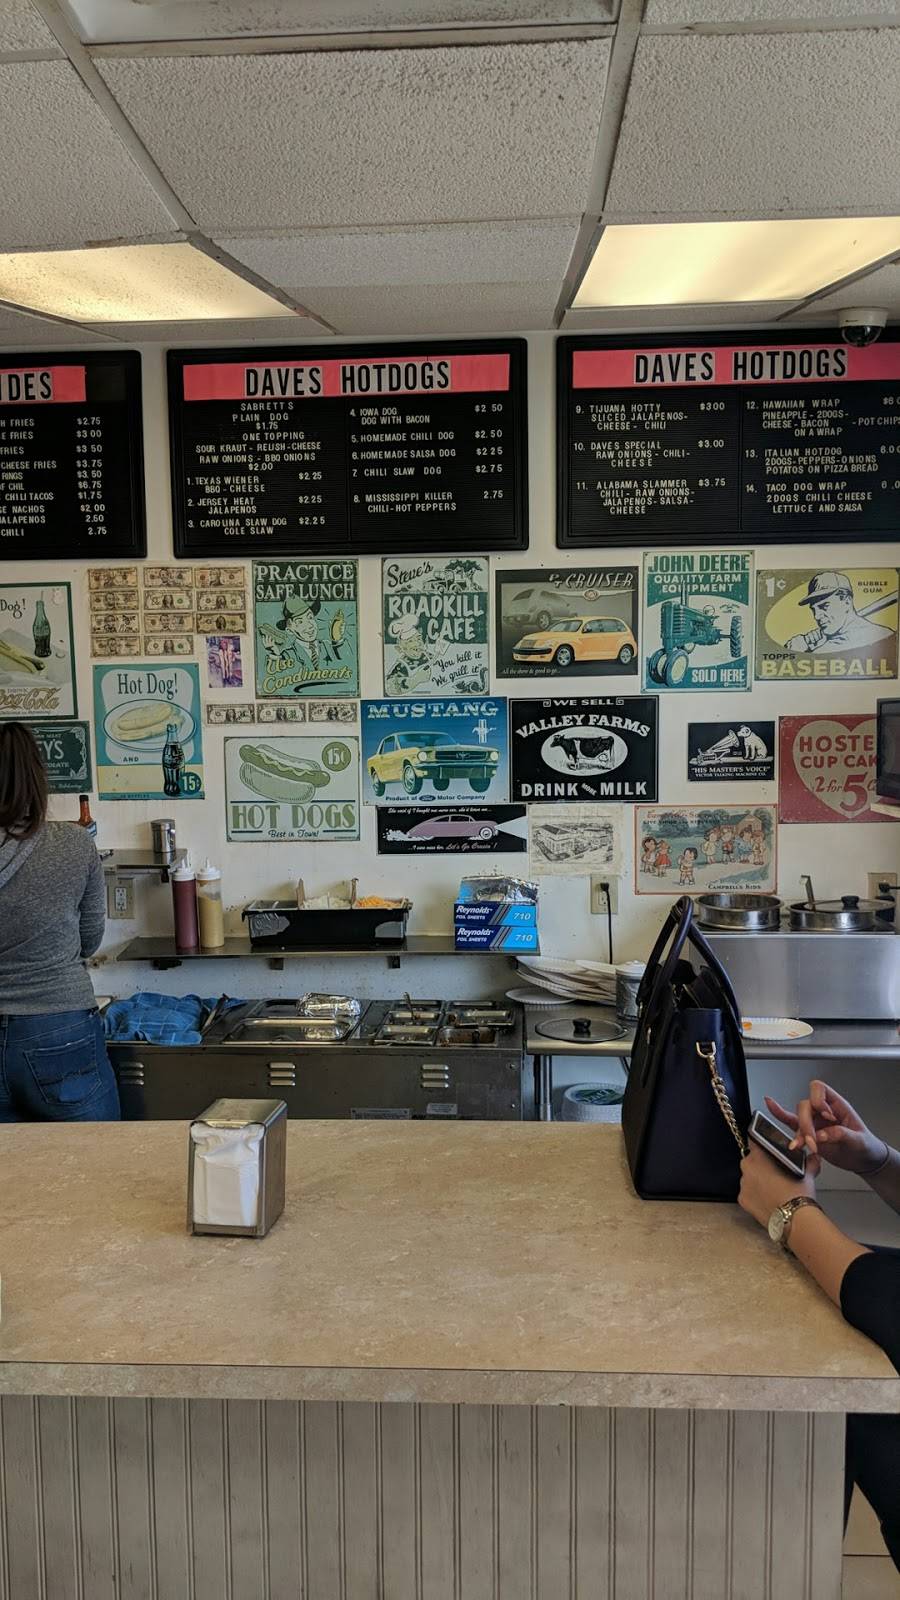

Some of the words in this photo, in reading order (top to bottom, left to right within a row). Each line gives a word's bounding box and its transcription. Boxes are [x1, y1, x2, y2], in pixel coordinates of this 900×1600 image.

[636, 352, 712, 382] DAVES
[734, 349, 846, 380] HOTDOGS
[246, 368, 321, 396] DAVES
[342, 361, 448, 393] HOTDOGS
[0, 372, 52, 401] DES
[763, 400, 804, 408] HAWAIIAN
[812, 400, 840, 408] WRAP
[590, 404, 626, 414] TIJUANA
[631, 404, 660, 412] HOTTY
[232, 414, 260, 422] PLAIN
[380, 416, 401, 424] WITH
[406, 415, 430, 423] BACON
[592, 413, 626, 422] SLICED
[763, 412, 806, 420] PINEAPPLE
[10, 418, 34, 427] FRIES
[256, 422, 278, 430] $1.75
[644, 422, 666, 430] CHILI
[10, 432, 34, 440] FRIES
[817, 428, 842, 436] WRAP
[243, 433, 260, 441] ONE
[361, 434, 406, 442] HOMEMADE
[196, 445, 216, 453] SOUR
[591, 442, 619, 450] DAVES
[625, 441, 661, 450] SPECIAL
[361, 451, 408, 460] HOMEMADE
[410, 450, 435, 458] SALSA
[596, 451, 614, 459] RAW
[805, 448, 842, 456] HOTDOG
[284, 453, 316, 461] ONIONS
[1, 461, 30, 469] CHEESE
[34, 461, 56, 469] FRIES
[76, 460, 102, 468] $3.75
[612, 459, 652, 467] CHEESE
[364, 468, 386, 476] CHILI
[394, 468, 414, 476] SLAW
[766, 466, 804, 474] POTATOS
[852, 464, 878, 472] BREAD
[224, 476, 260, 484] WIENER
[597, 480, 638, 490] ALABAMA
[643, 480, 686, 488] SLAMMER
[699, 478, 726, 486] $3.75
[794, 483, 812, 491] DOG
[819, 482, 847, 490] WRAP
[29, 492, 54, 500] TACOS
[366, 494, 419, 502] MISSISSIPPI
[425, 492, 452, 500] KILLER
[484, 491, 503, 499] 2.75
[636, 489, 654, 497] RAW
[234, 497, 255, 505] HEAT
[767, 494, 798, 502] 2DOGS
[12, 505, 45, 513] NACHOS
[208, 506, 256, 514] JALAPENOS
[416, 503, 456, 511] PEPPERS
[610, 506, 645, 514] CHEESE
[773, 505, 812, 513] LETTUCE
[200, 519, 240, 527] CAROLINA
[246, 518, 267, 526] SLAW
[88, 527, 106, 535] 2.75
[224, 527, 244, 535] COLE
[648, 556, 694, 572] JOHN
[700, 554, 750, 572] DEERE
[257, 564, 354, 581] PRACTICE
[387, 561, 434, 588] Steve's
[565, 572, 634, 588] CRUISER
[654, 575, 704, 584] QUALITY
[710, 574, 742, 582] FARM
[256, 584, 294, 600] SAFE
[300, 584, 354, 600] LUNCH
[0, 599, 26, 619] Dog!
[388, 595, 484, 618] ROADKILL
[427, 618, 476, 640] CAFE
[457, 651, 472, 663] kill
[266, 656, 294, 674] Use
[762, 659, 894, 676] BASEBALL
[263, 665, 352, 693] Condiments
[692, 669, 717, 682] SOLD
[720, 668, 746, 682] HERE
[117, 674, 142, 694] Hot
[146, 672, 178, 700] Dog!
[368, 702, 498, 718] MUSTANG
[516, 714, 586, 738] VALLEY
[588, 714, 650, 736] FARMS
[801, 735, 874, 752] HOSTE
[801, 757, 838, 768] CUP
[521, 783, 578, 796] DRINK
[600, 782, 647, 795] MILK
[815, 777, 826, 792] 2
[232, 804, 280, 829] HOT
[291, 804, 356, 829] DOGS
[268, 830, 286, 838] Best
[456, 906, 490, 914] Reynolds
[458, 928, 491, 936] Reynolds
